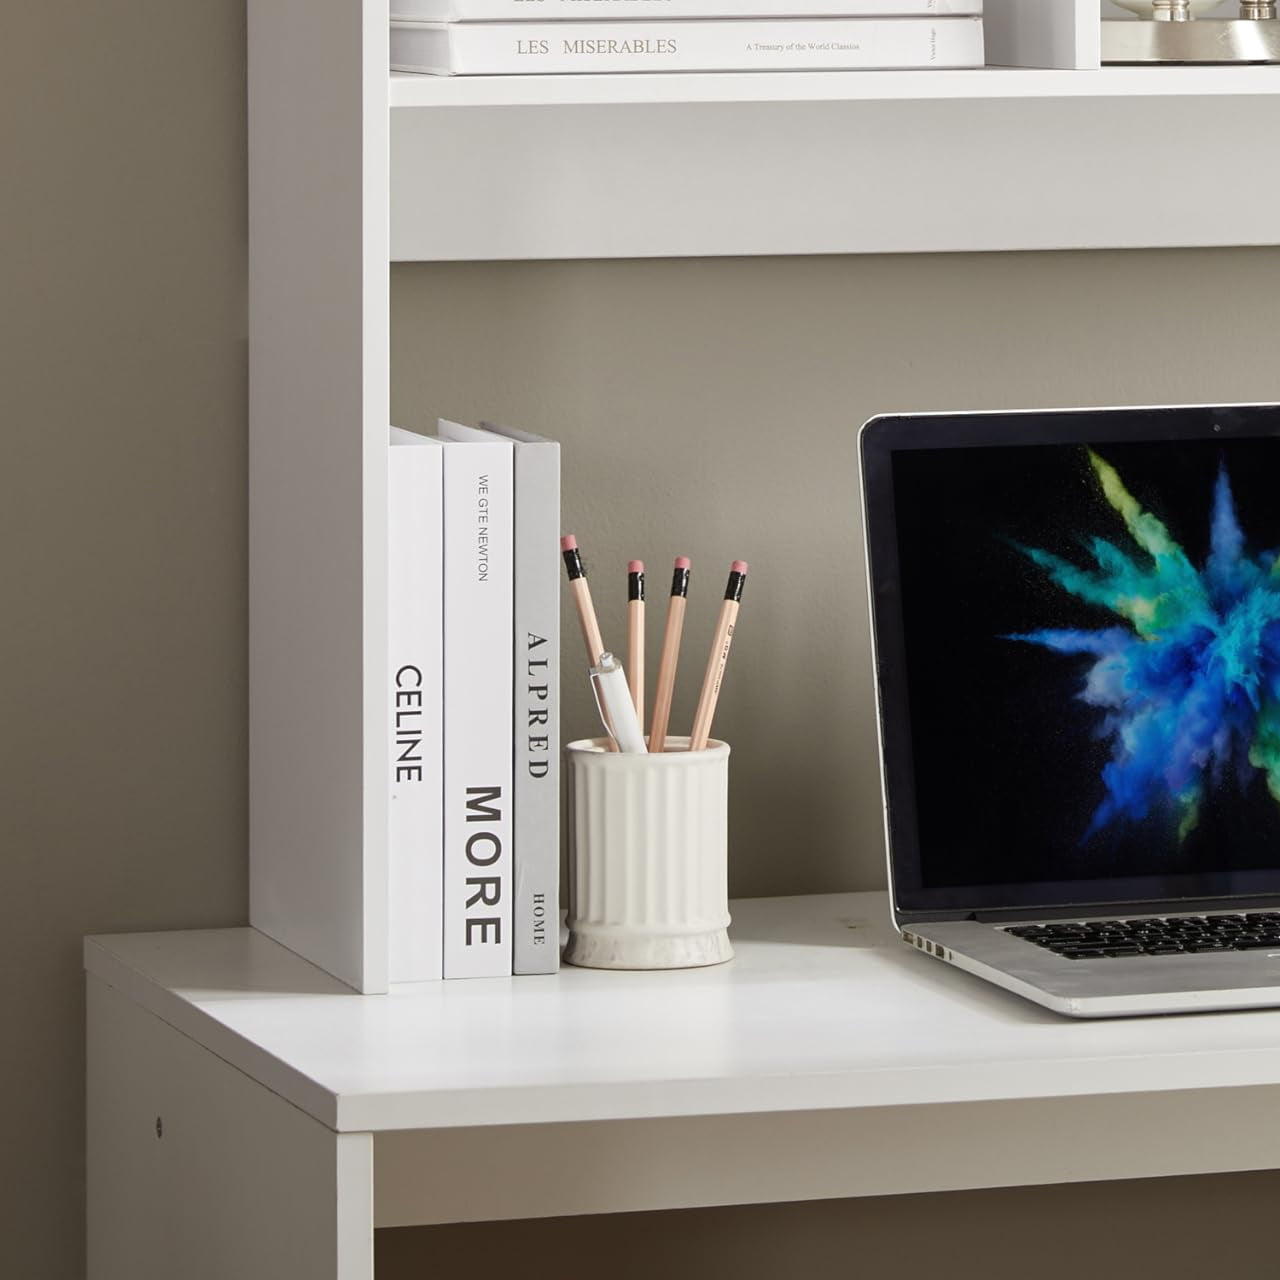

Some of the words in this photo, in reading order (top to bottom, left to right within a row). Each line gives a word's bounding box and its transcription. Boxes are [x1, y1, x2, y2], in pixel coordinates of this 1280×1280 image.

[517, 40, 549, 54] LES
[564, 40, 676, 54] MISERABLES
[754, 43, 784, 52] Treasury
[794, 43, 806, 51] the
[478, 498, 488, 523] GTE
[479, 475, 488, 494] WE
[478, 527, 488, 581] NEWTON
[396, 665, 422, 782] CELINE
[528, 632, 548, 778] ALPRED
[465, 786, 501, 946] MORE
[534, 894, 544, 944] HOME
